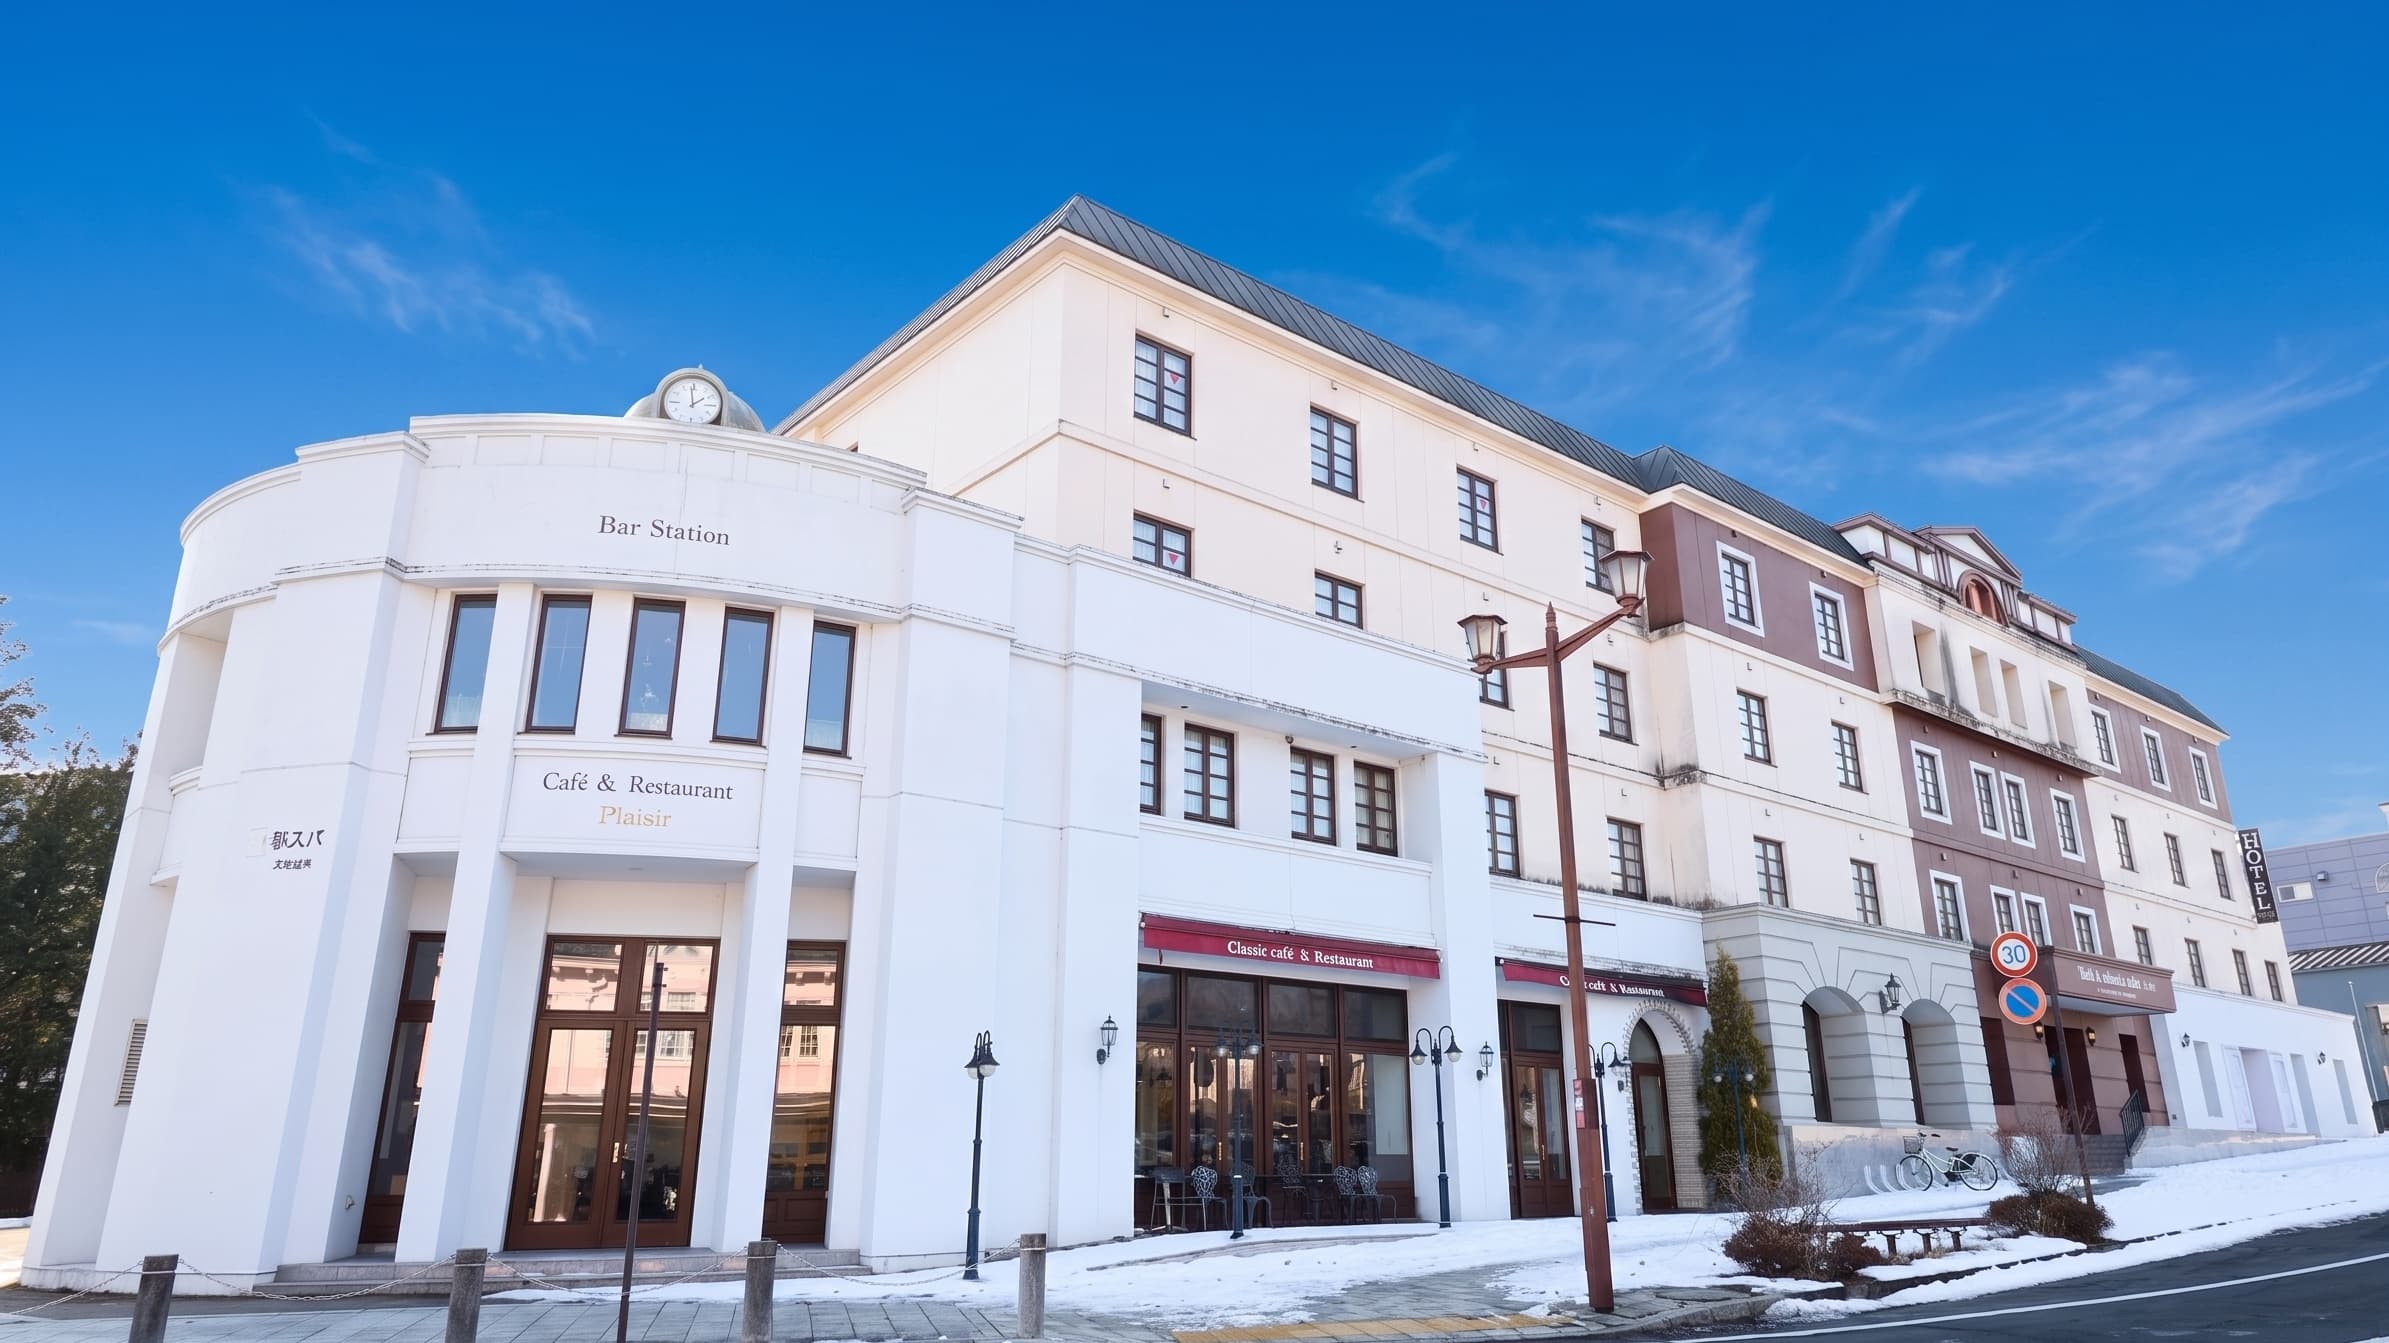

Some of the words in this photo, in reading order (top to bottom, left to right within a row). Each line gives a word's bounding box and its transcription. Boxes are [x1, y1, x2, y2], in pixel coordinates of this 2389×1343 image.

[598, 515, 641, 536] Bar
[650, 519, 730, 545] Station
[543, 772, 588, 791] Café
[597, 773, 616, 792] &
[629, 775, 733, 800] Restaurant
[599, 805, 671, 827] Plaisir
[2241, 832, 2271, 910] HOTEL
[1227, 940, 1268, 958] Classic
[1270, 946, 1294, 961] café
[1300, 949, 1310, 962] &
[1314, 950, 1374, 969] Restaurant
[2001, 945, 2027, 964] 30
